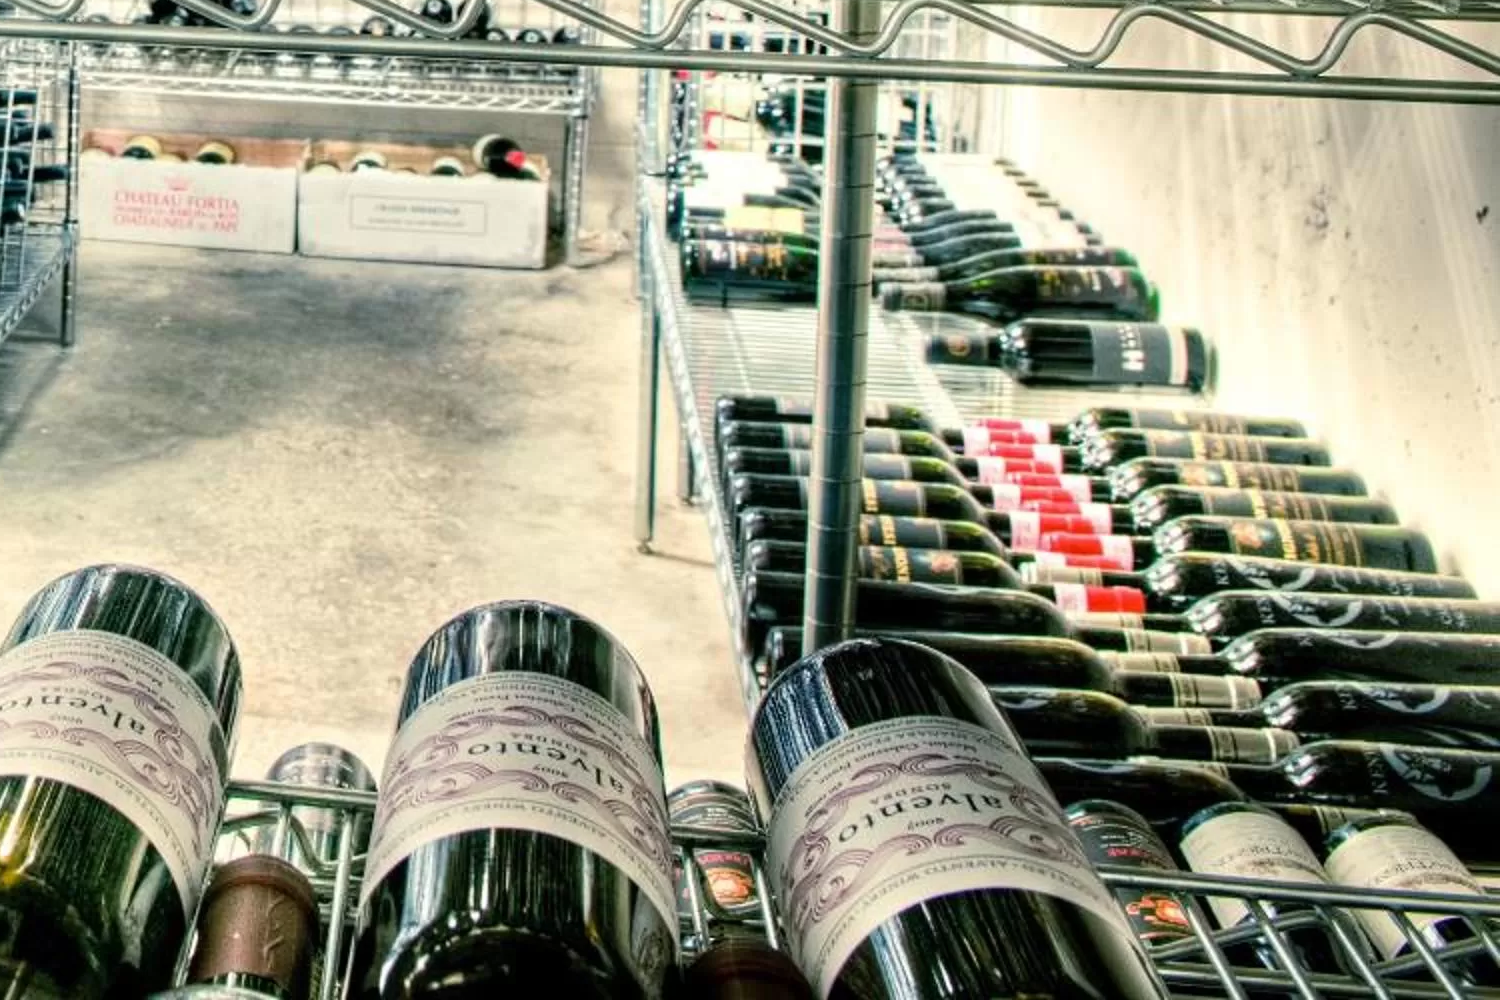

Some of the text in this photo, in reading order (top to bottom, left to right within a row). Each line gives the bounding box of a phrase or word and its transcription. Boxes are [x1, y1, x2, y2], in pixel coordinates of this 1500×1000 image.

[114, 190, 240, 209] CHATEAU FORTIA
[467, 741, 626, 794] alvento
[838, 792, 1003, 843] alvento
